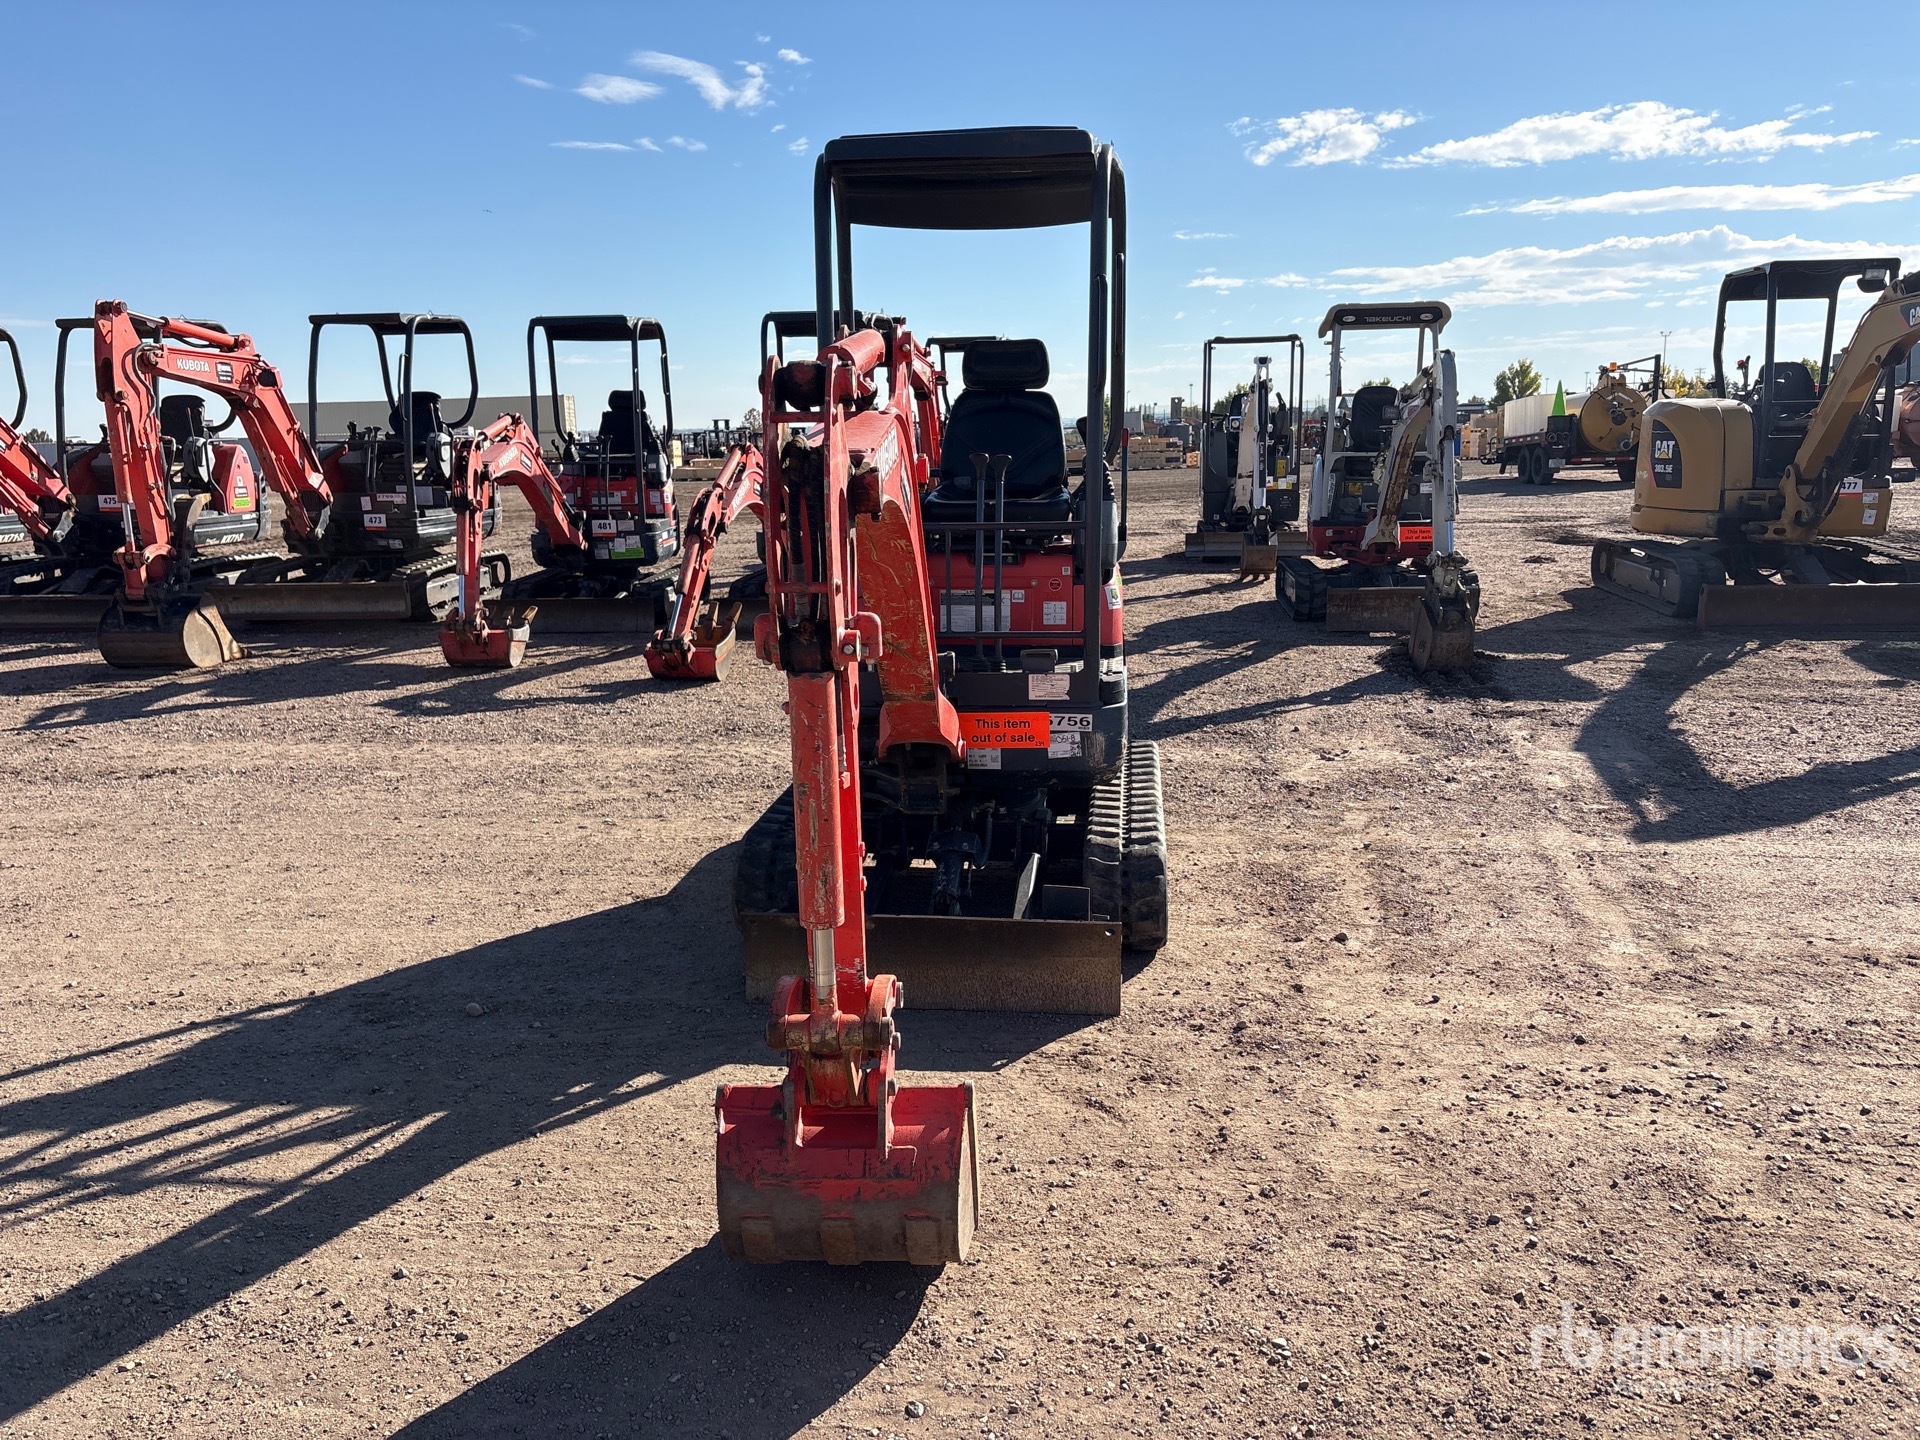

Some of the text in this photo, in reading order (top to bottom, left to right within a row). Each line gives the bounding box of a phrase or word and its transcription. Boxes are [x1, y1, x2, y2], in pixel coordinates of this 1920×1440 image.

[176, 358, 211, 373] KUBOTA
[1654, 440, 1676, 459] CAT
[103, 497, 117, 505] 475
[368, 516, 382, 524] 473
[597, 522, 612, 530] 481
[975, 718, 1031, 729] This item
[971, 732, 1035, 743] out of sale
